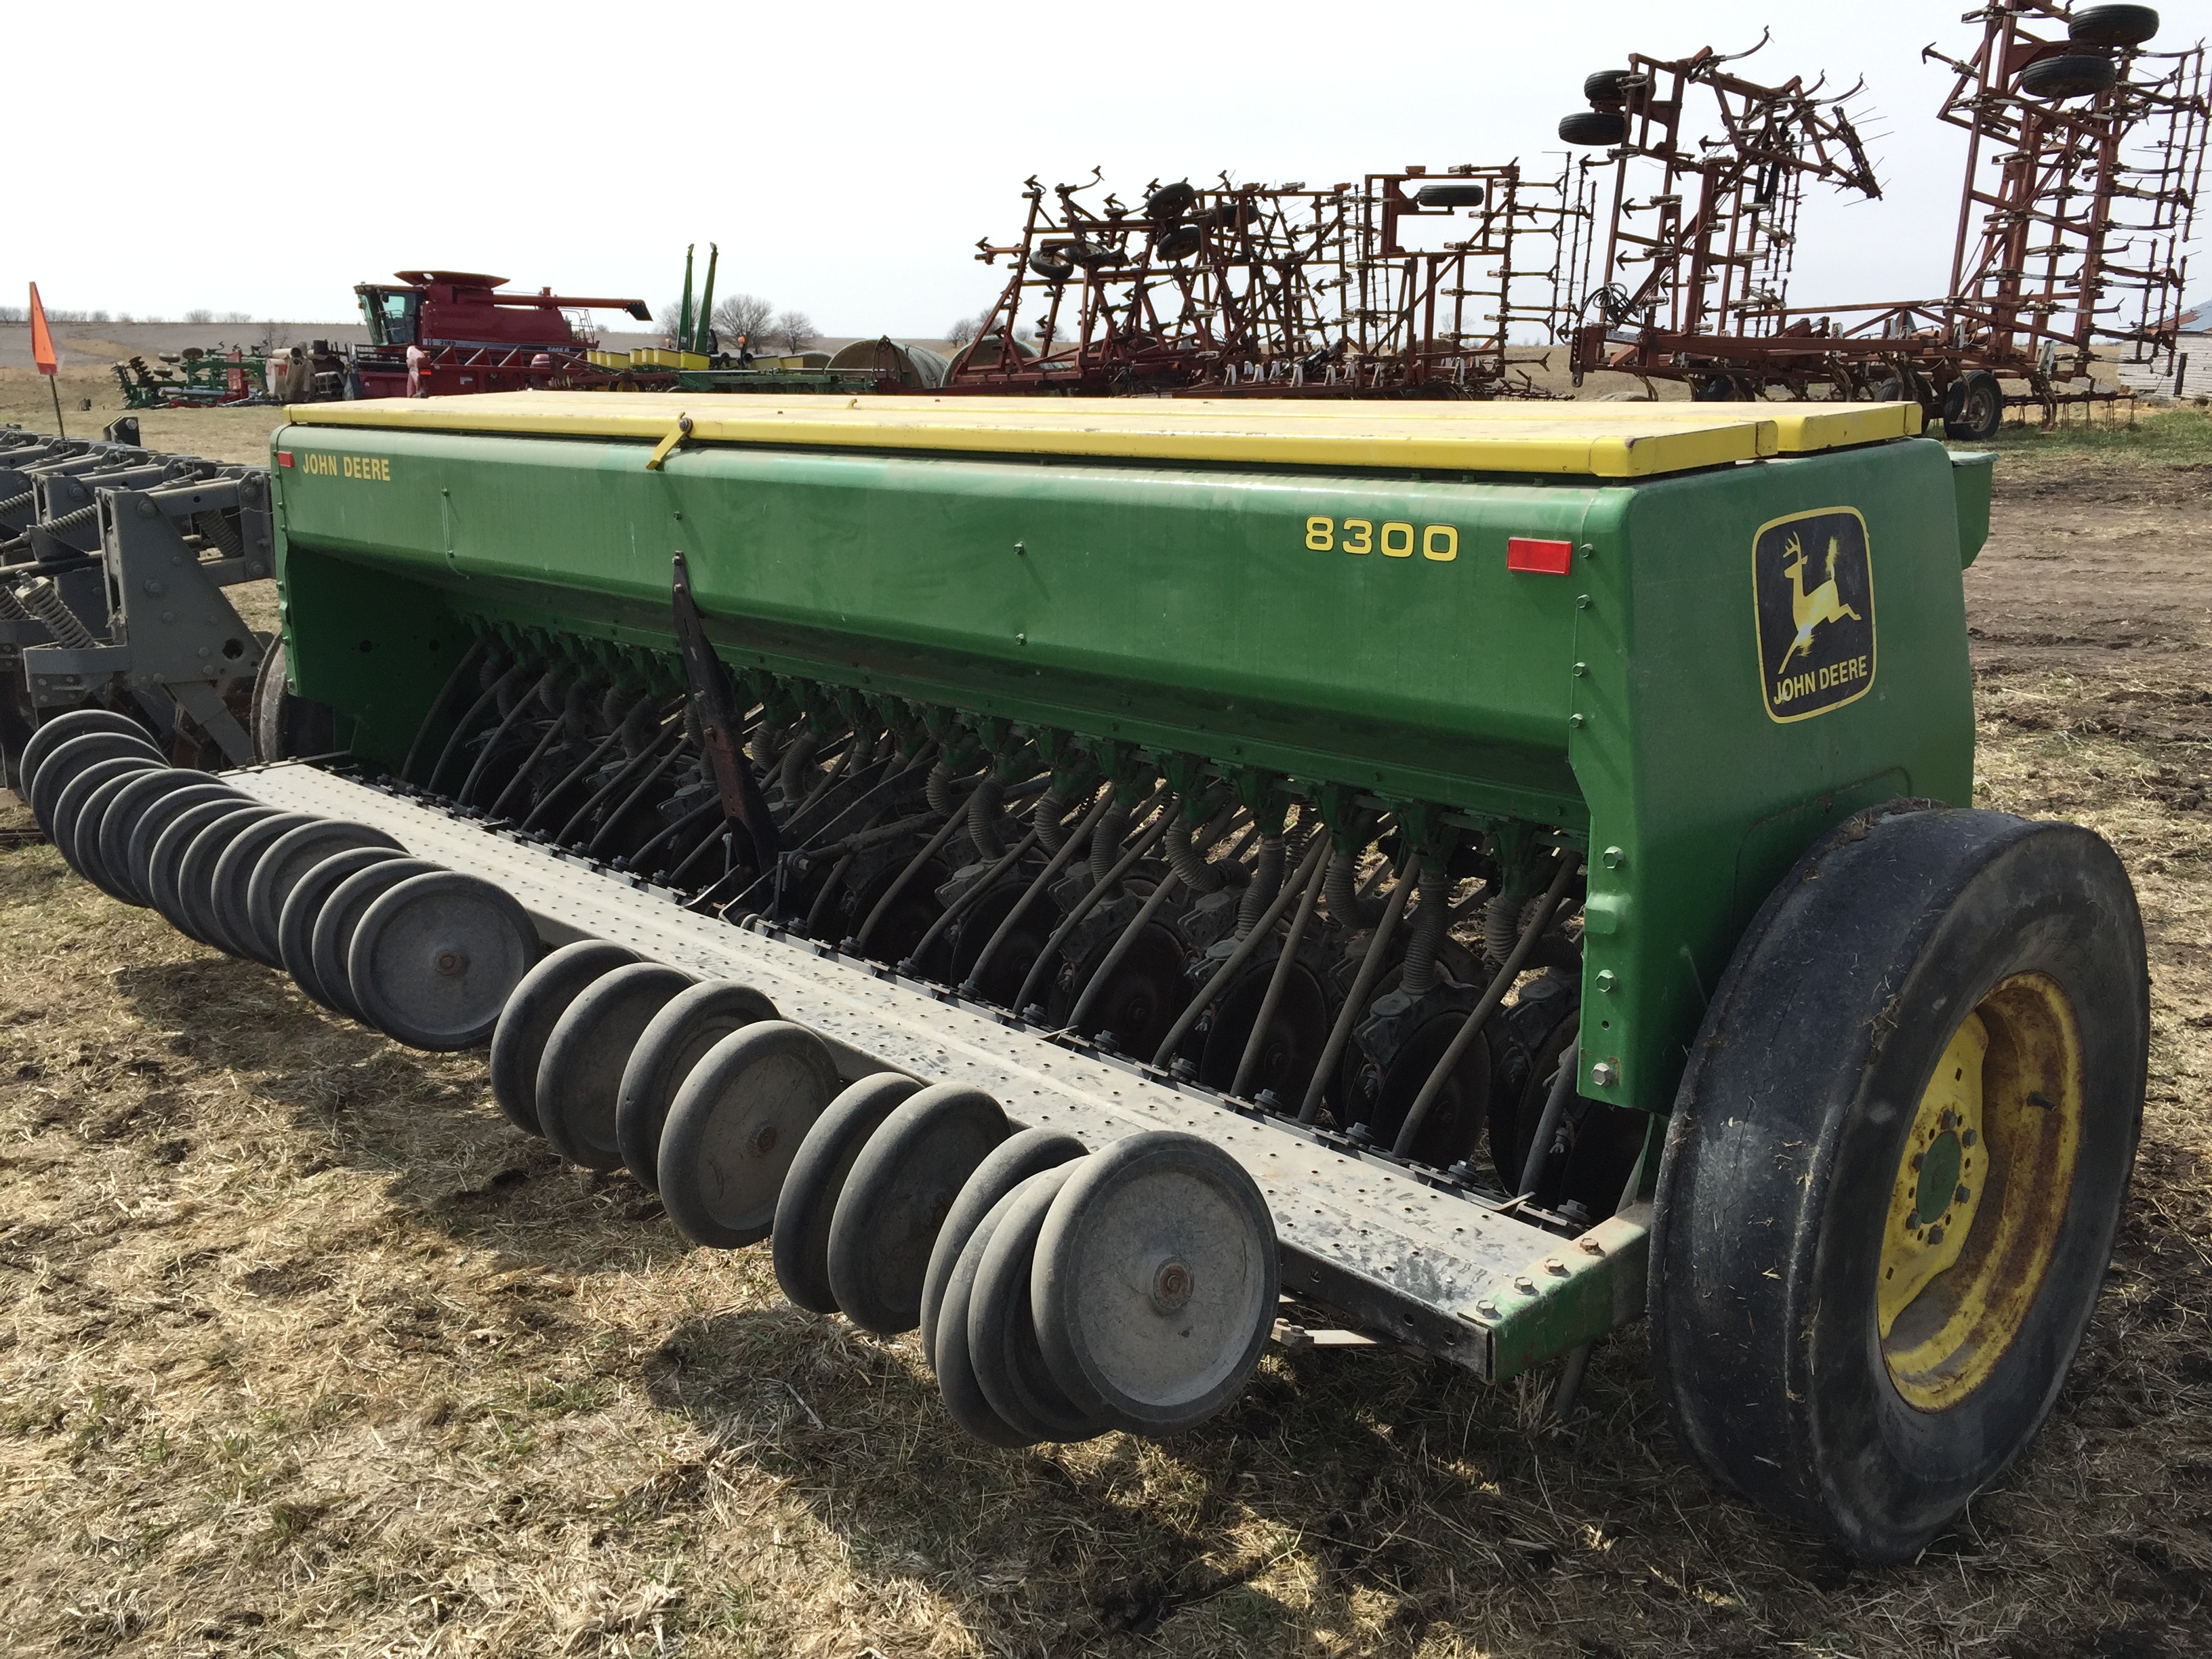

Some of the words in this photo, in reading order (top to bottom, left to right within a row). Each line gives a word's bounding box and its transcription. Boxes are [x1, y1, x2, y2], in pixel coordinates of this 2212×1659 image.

[303, 453, 337, 476] JOHN
[343, 456, 390, 481] DEERE
[1305, 515, 1459, 562] 8300
[1774, 671, 1816, 705] JOHN
[1819, 655, 1868, 690] DEERE
